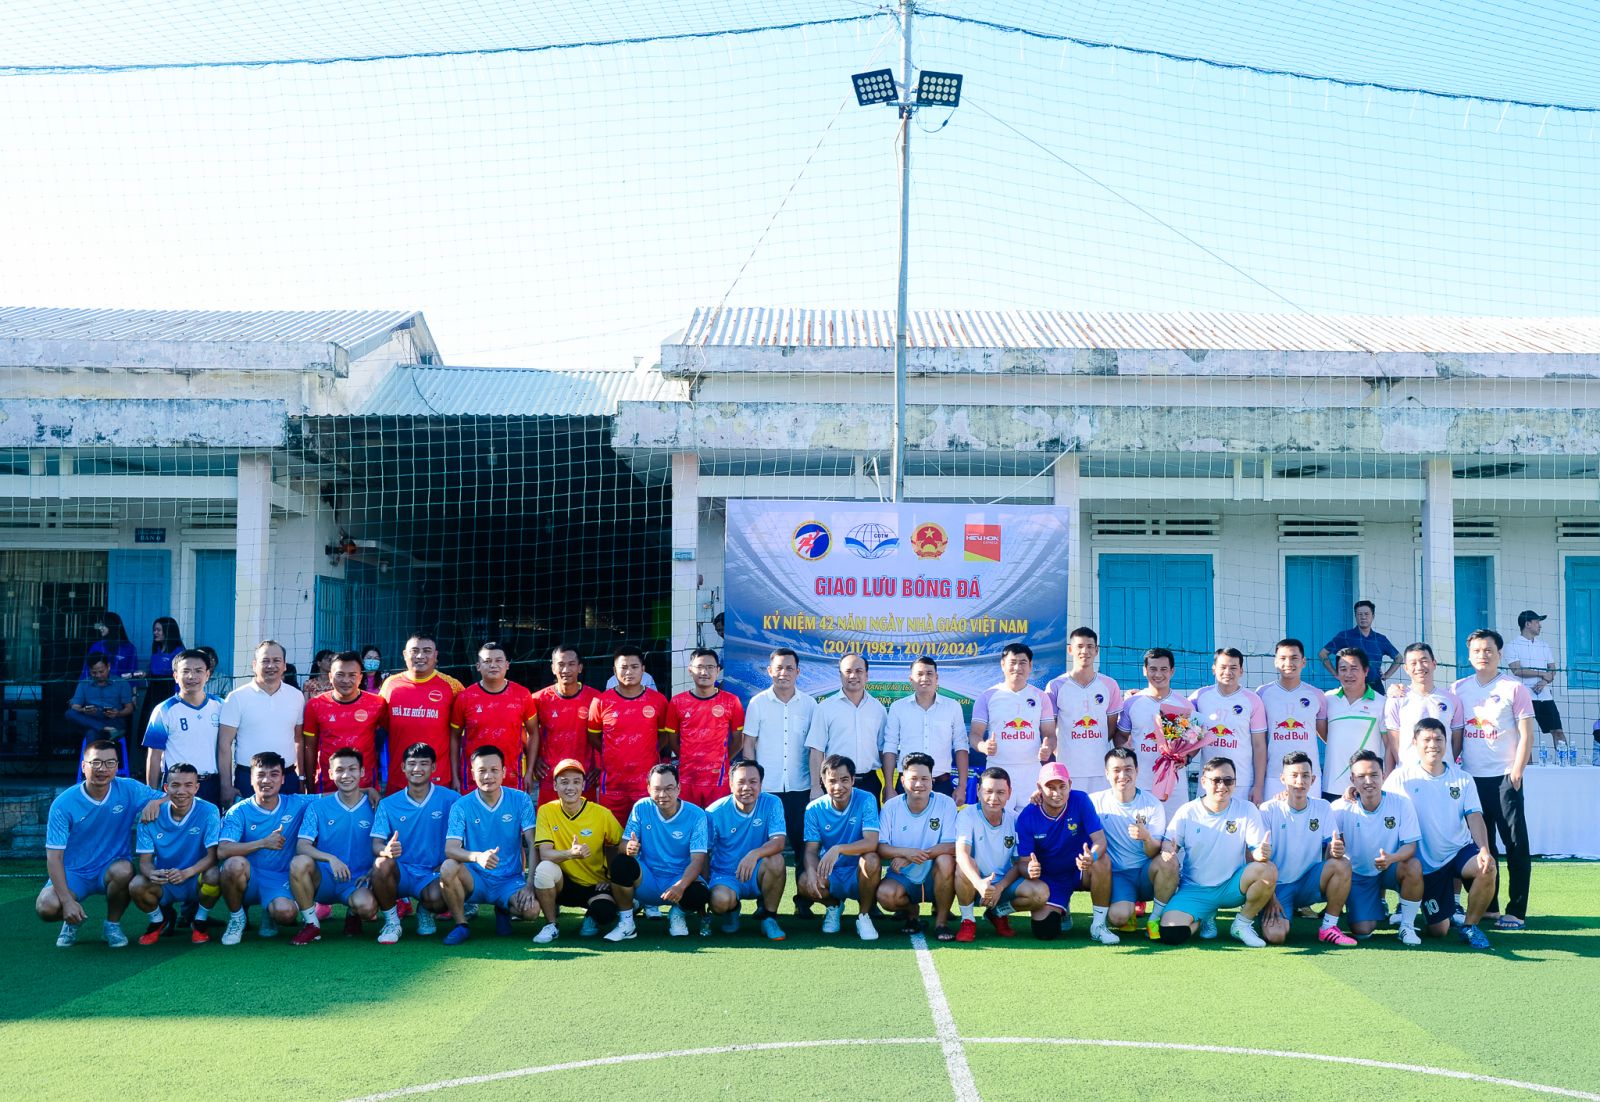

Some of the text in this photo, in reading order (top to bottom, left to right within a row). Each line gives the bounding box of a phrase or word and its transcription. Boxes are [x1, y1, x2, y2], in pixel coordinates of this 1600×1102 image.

[815, 574, 982, 599] GIAO LƯU BÓNG ĐÁ
[763, 610, 1028, 636] KỶ NIỆM 42 NĂM NGÀY NHÀ GIÁO VIỆT NAM
[823, 639, 894, 654] (20/11/1982
[904, 641, 979, 656] 20/11/2024)
[402, 707, 411, 717] XE
[426, 708, 439, 719] HOA
[180, 717, 188, 731] 8
[1001, 731, 1034, 740] Red Bull
[1071, 730, 1087, 740] Red
[1273, 731, 1308, 740] Red Bull
[1479, 730, 1498, 739] Bull
[1141, 743, 1157, 752] Red
[1207, 737, 1237, 748] ed Bull
[1424, 899, 1439, 915] 10
